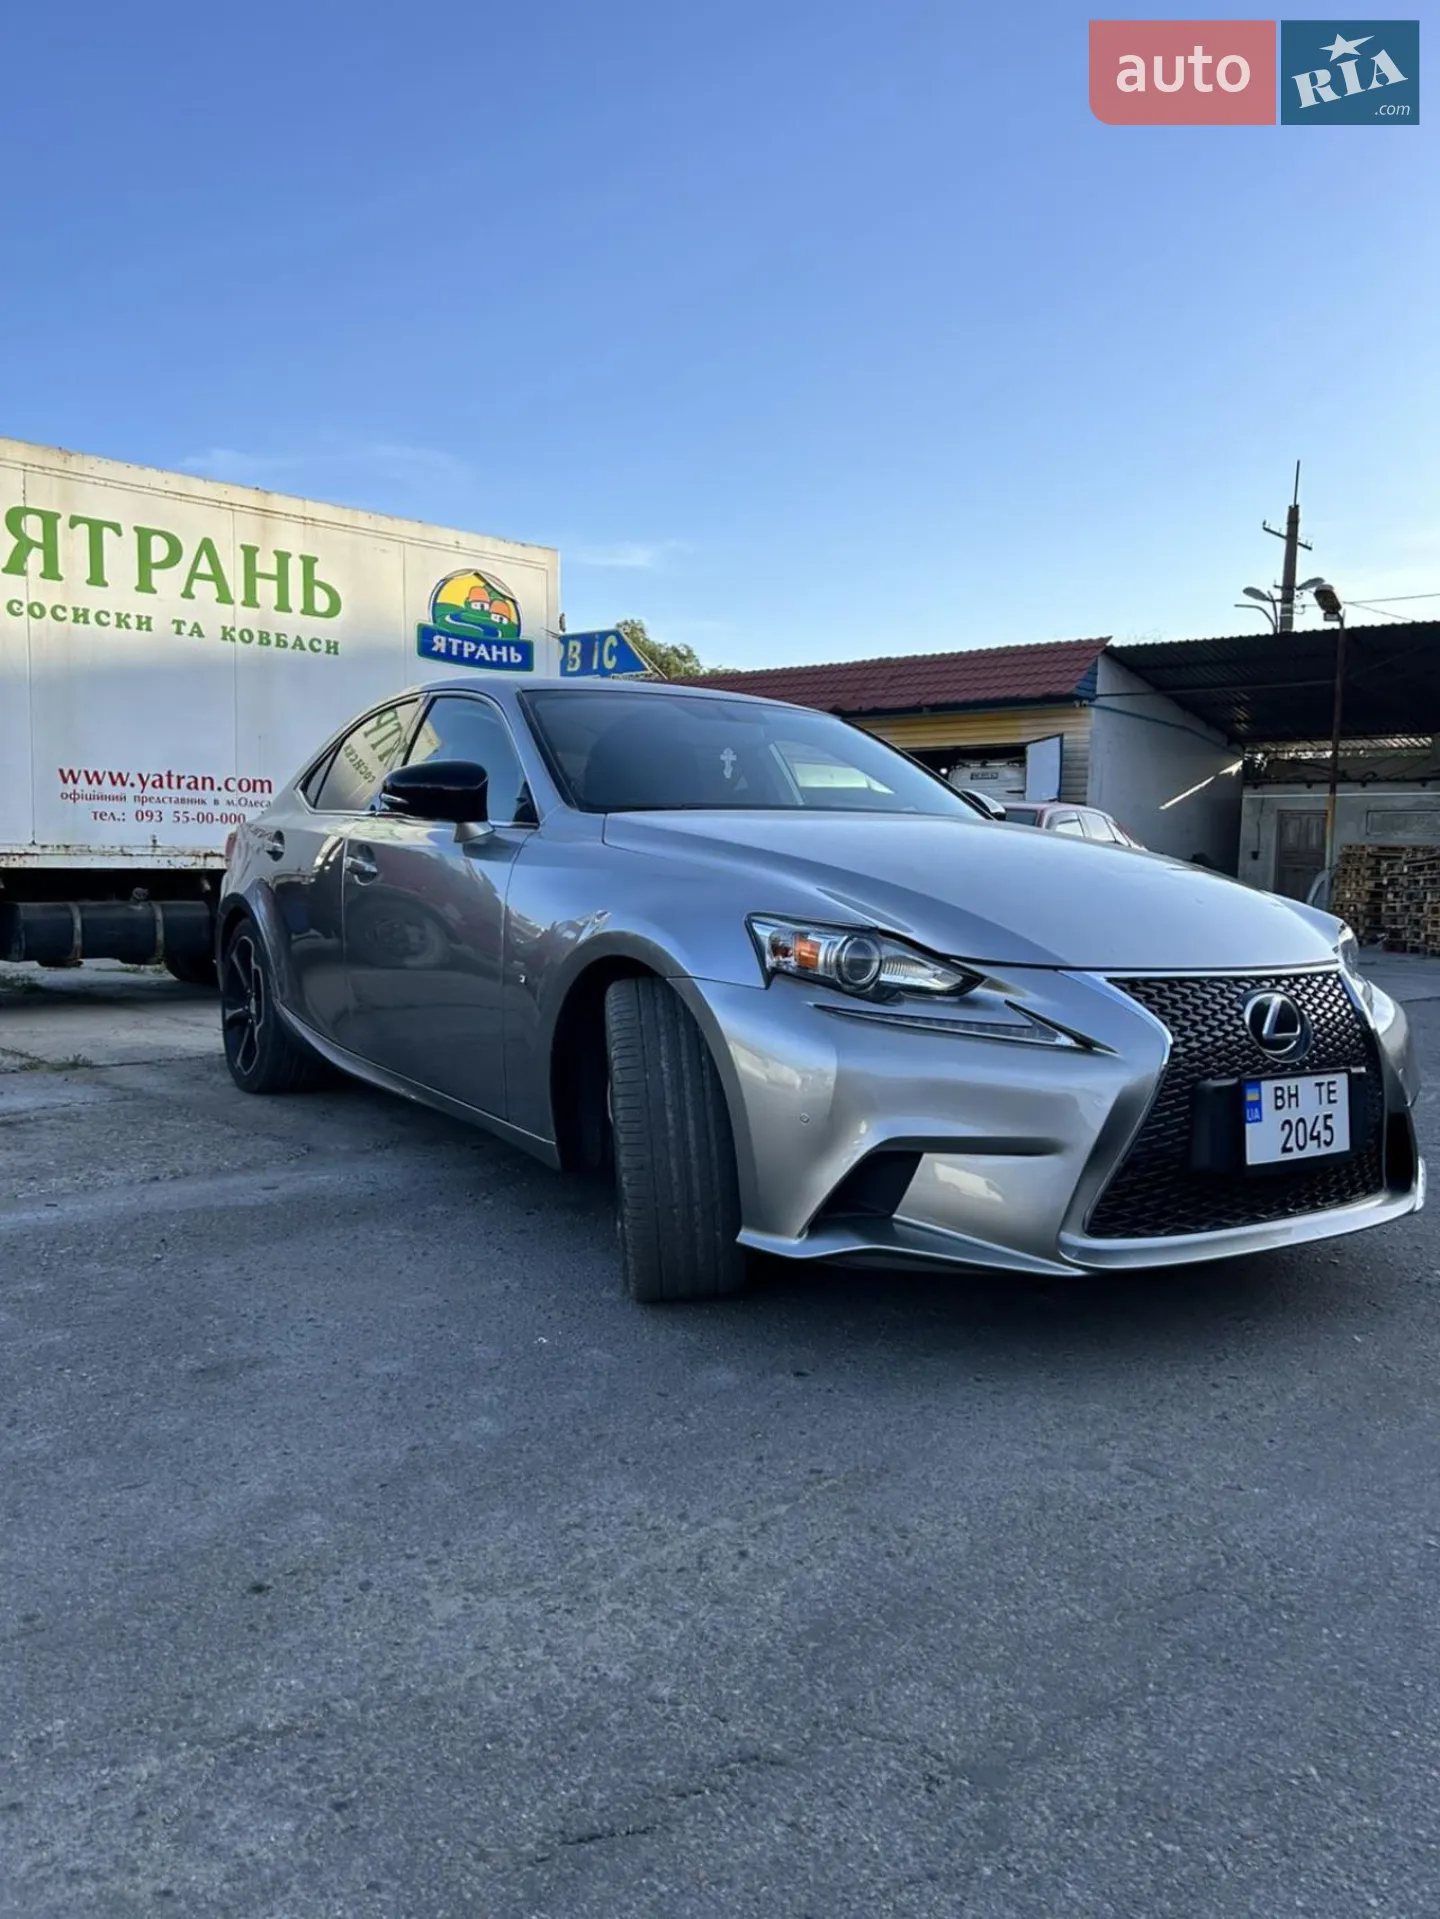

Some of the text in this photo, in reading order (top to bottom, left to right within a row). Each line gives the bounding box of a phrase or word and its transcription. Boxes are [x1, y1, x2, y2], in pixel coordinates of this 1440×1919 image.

[1, 506, 342, 619] ЯТРАНЬ
[432, 634, 523, 664] ЯТРАНЬ
[58, 768, 273, 794] www.yatran.com
[133, 794, 207, 806] представник
[135, 809, 163, 823] 093
[172, 811, 246, 825] 55-00-000
[1274, 1081, 1338, 1111] BH TE
[1246, 1107, 1261, 1121] UA
[1280, 1113, 1334, 1154] 2045
